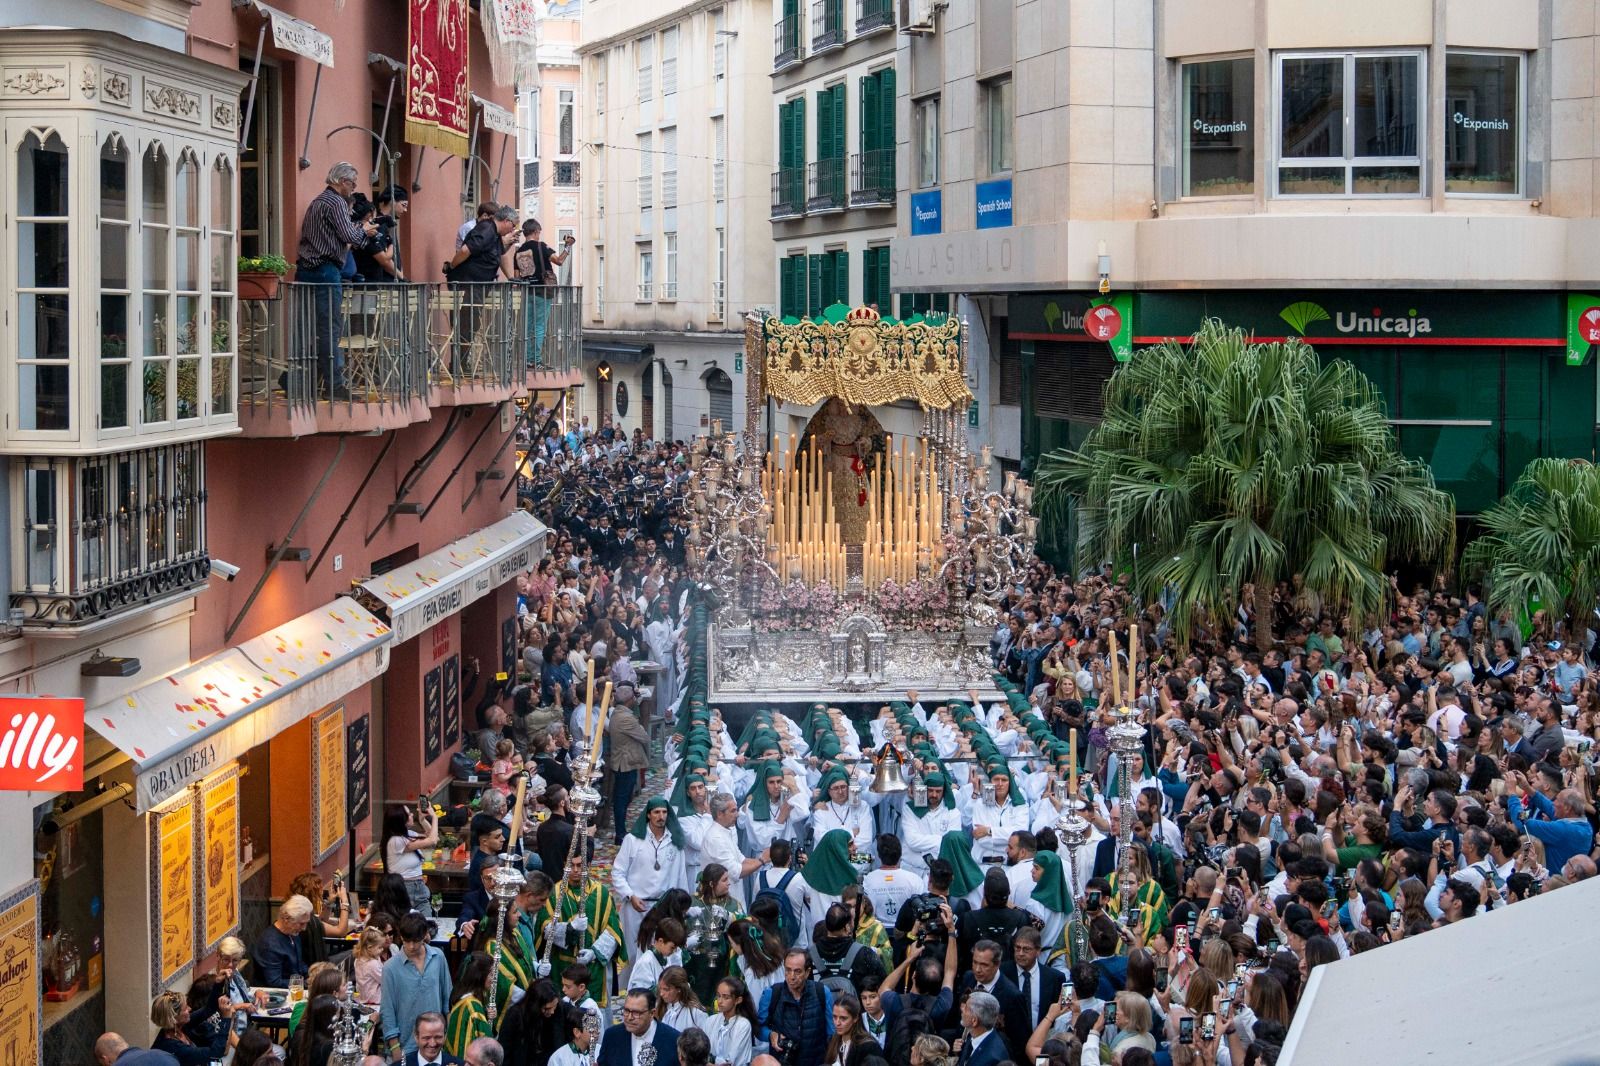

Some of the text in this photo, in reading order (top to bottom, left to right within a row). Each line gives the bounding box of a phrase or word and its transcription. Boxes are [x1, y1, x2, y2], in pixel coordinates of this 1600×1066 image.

[1202, 120, 1247, 136] Expanish
[1463, 117, 1509, 132] Expanish
[919, 208, 937, 222] Expanish
[977, 198, 1012, 216] Spanish School
[1336, 307, 1432, 338] Unicaja
[1568, 348, 1579, 361] 24
[0, 711, 79, 783] illy
[0, 958, 29, 985] ahou
